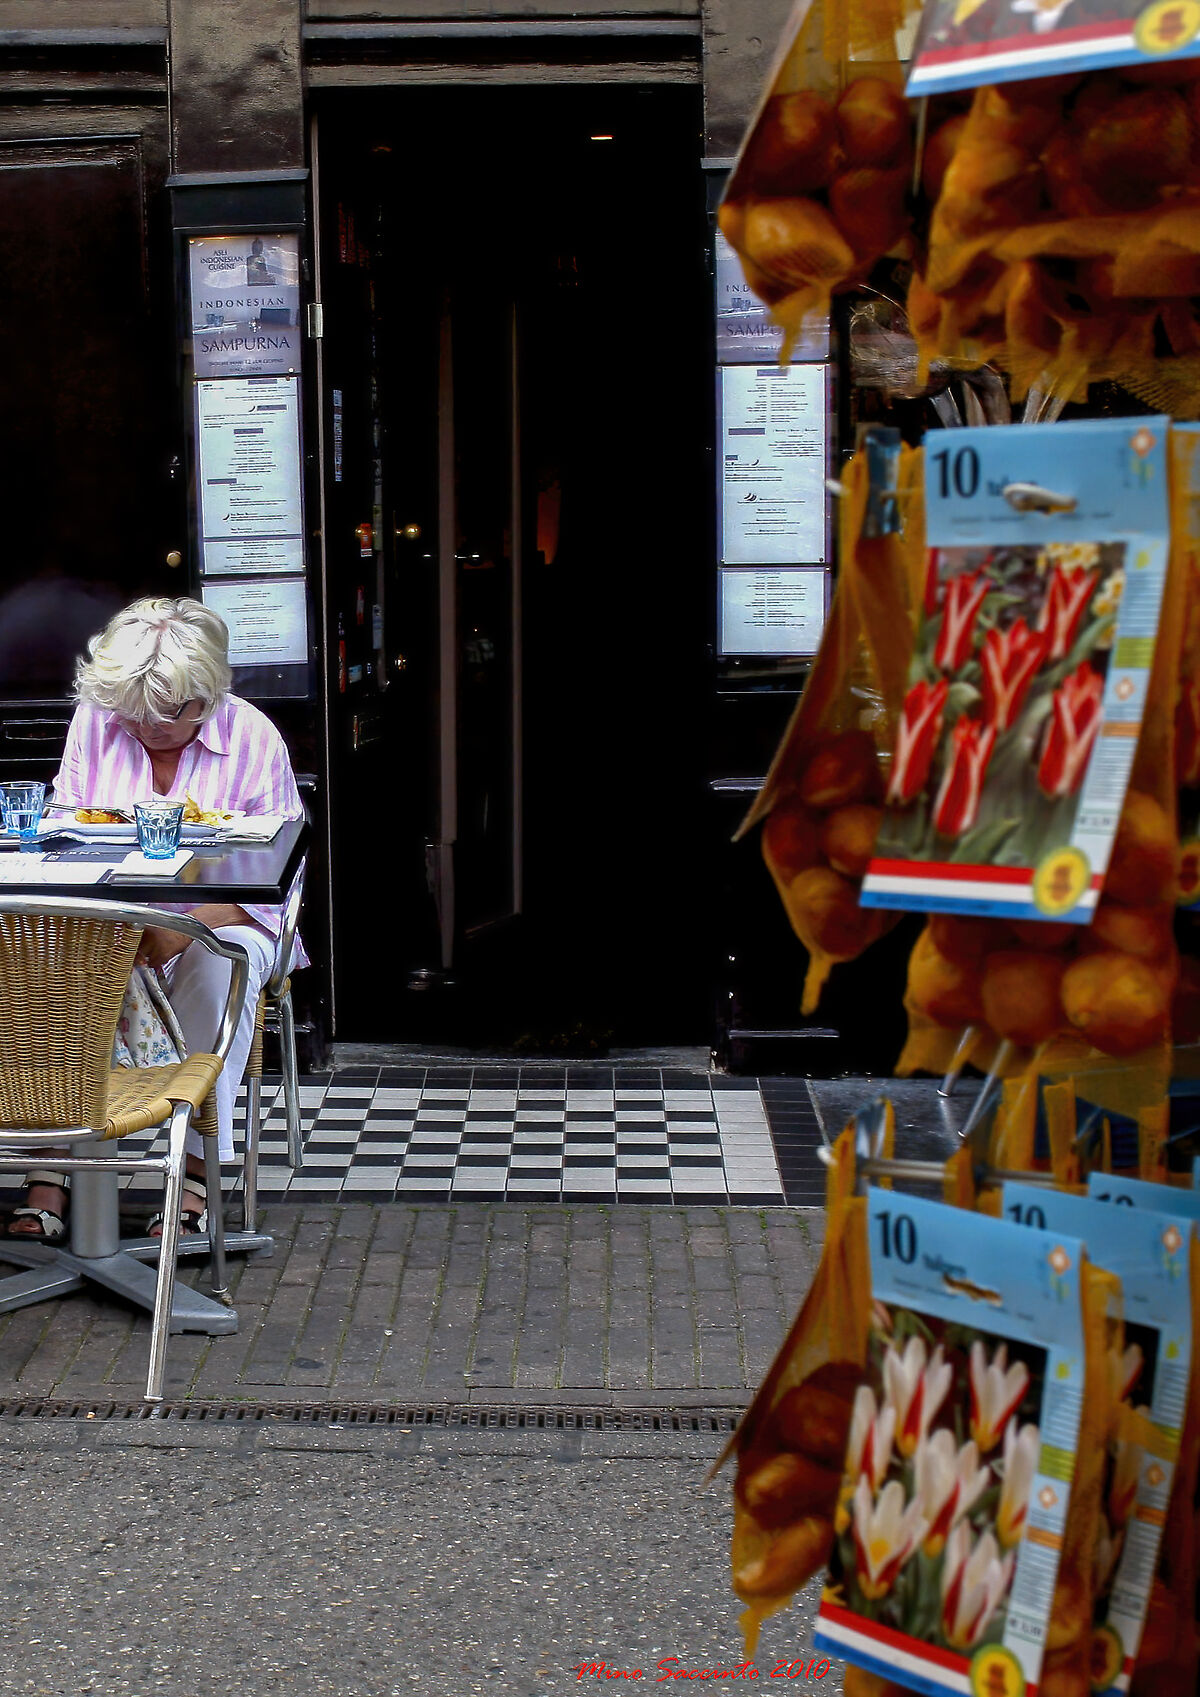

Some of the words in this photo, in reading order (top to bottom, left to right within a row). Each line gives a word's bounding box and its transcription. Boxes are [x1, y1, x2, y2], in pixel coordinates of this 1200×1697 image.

[200, 255, 243, 264] INDONESIAN
[208, 263, 235, 271] CUISINE
[200, 297, 284, 309] INDONESIAN
[201, 336, 291, 353] SAMPURNA
[931, 446, 980, 499] 10
[874, 1210, 918, 1264] 10
